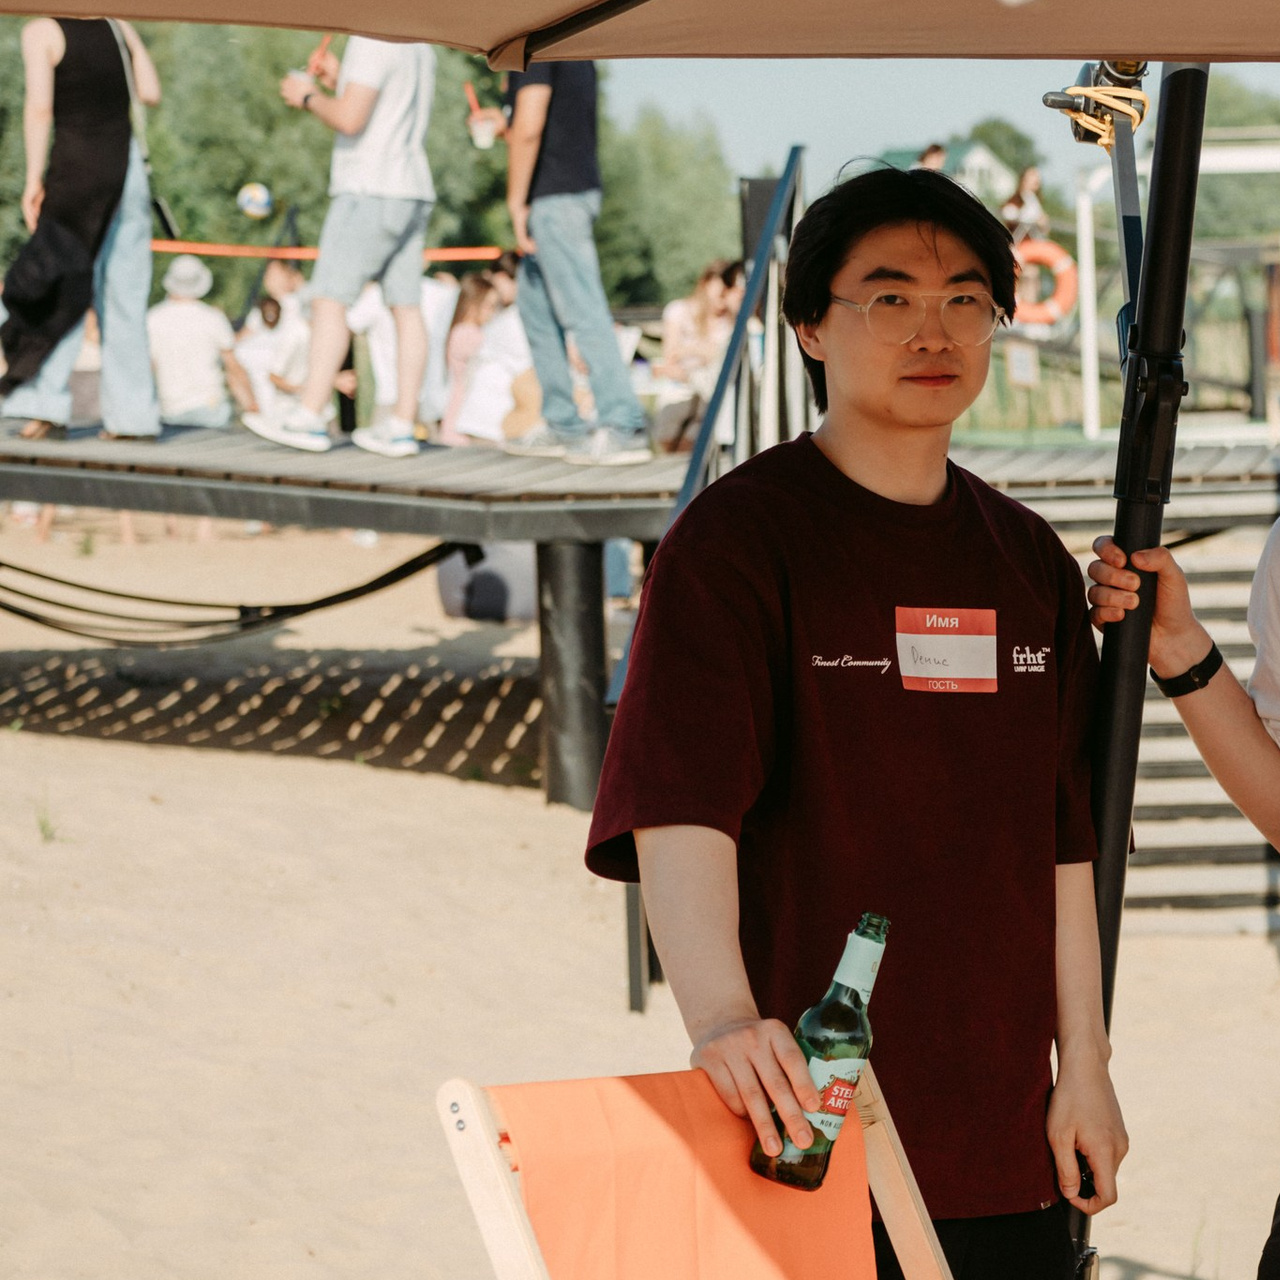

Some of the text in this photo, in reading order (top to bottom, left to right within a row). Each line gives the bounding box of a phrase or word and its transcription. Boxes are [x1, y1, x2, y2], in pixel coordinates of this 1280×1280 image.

[926, 614, 959, 628] Имя
[840, 654, 892, 674] Community
[928, 680, 958, 690] ГОСТЬ
